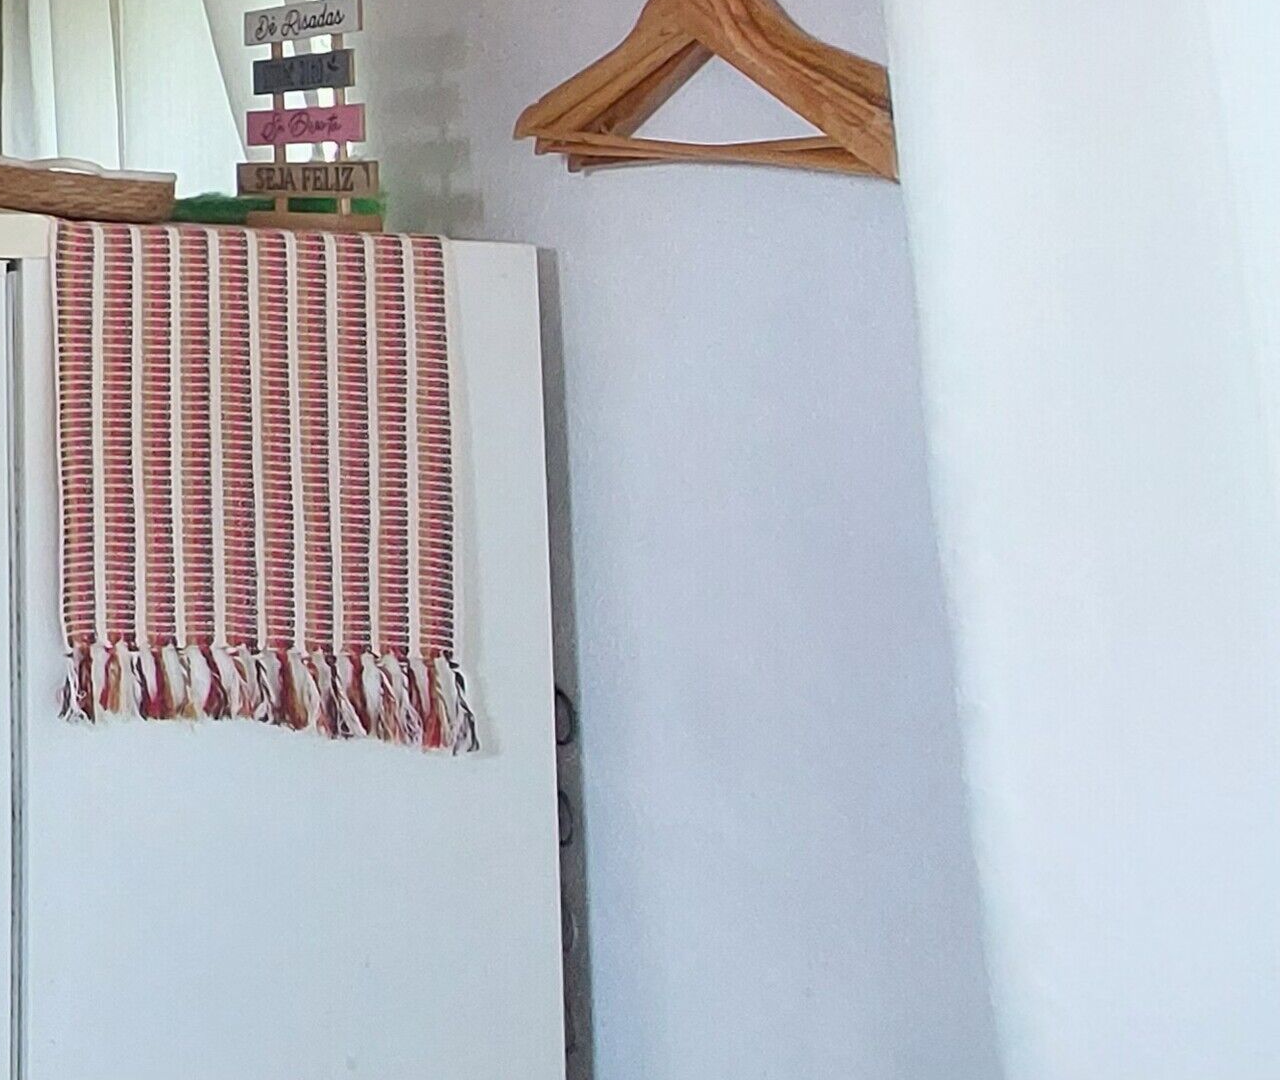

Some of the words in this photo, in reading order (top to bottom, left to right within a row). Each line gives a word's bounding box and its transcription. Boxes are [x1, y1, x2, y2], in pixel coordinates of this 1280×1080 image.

[280, 3, 346, 37] Risadas
[255, 167, 297, 192] SEJA
[301, 166, 354, 192] FELIZ
